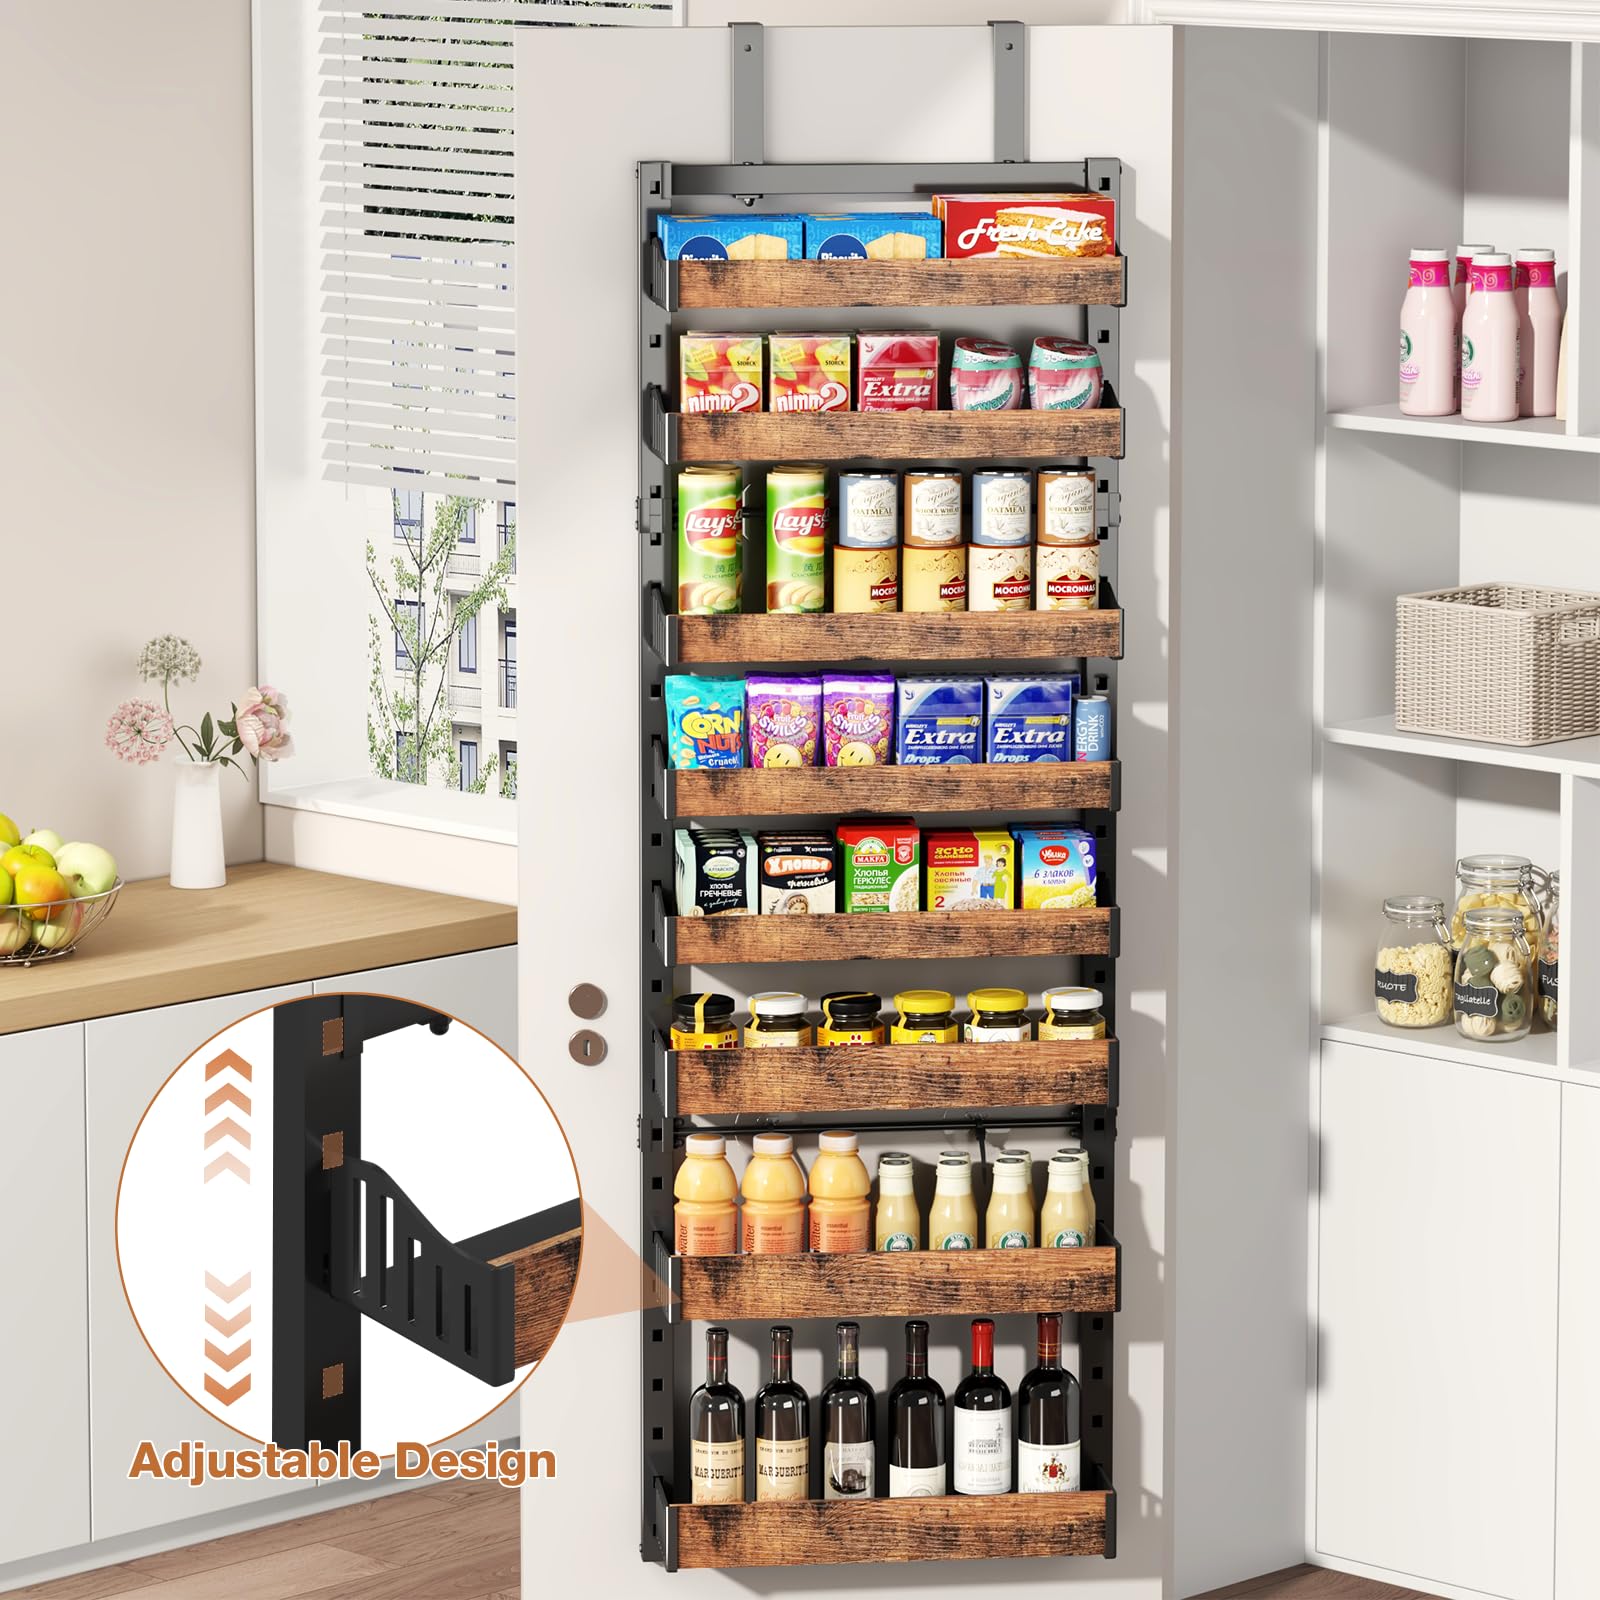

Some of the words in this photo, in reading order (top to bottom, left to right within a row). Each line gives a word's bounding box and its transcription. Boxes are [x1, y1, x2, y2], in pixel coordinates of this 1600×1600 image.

[957, 218, 1039, 250] Fresh
[1043, 217, 1103, 246] Cake
[864, 382, 931, 397] Extra
[686, 513, 733, 536] Lay's
[774, 512, 822, 535] Lay's
[1048, 583, 1096, 593] MOCRONNAS
[682, 711, 740, 739] CORN
[759, 715, 807, 737] SMILES
[832, 713, 881, 736] SMILES
[904, 728, 977, 745] Extra
[993, 727, 1065, 744] Extra
[1088, 714, 1099, 752] DRINK
[697, 733, 742, 754] NUTS
[904, 753, 942, 765] Drops
[993, 752, 1030, 763] Drops
[934, 846, 974, 855] ЯСНО
[853, 876, 891, 885] ГЕРКУЛЕС
[1034, 869, 1040, 878] 6
[699, 889, 742, 898] ГРЕЧНЕВЫЕ
[935, 896, 945, 908] 2
[1377, 980, 1407, 992] RUOTE
